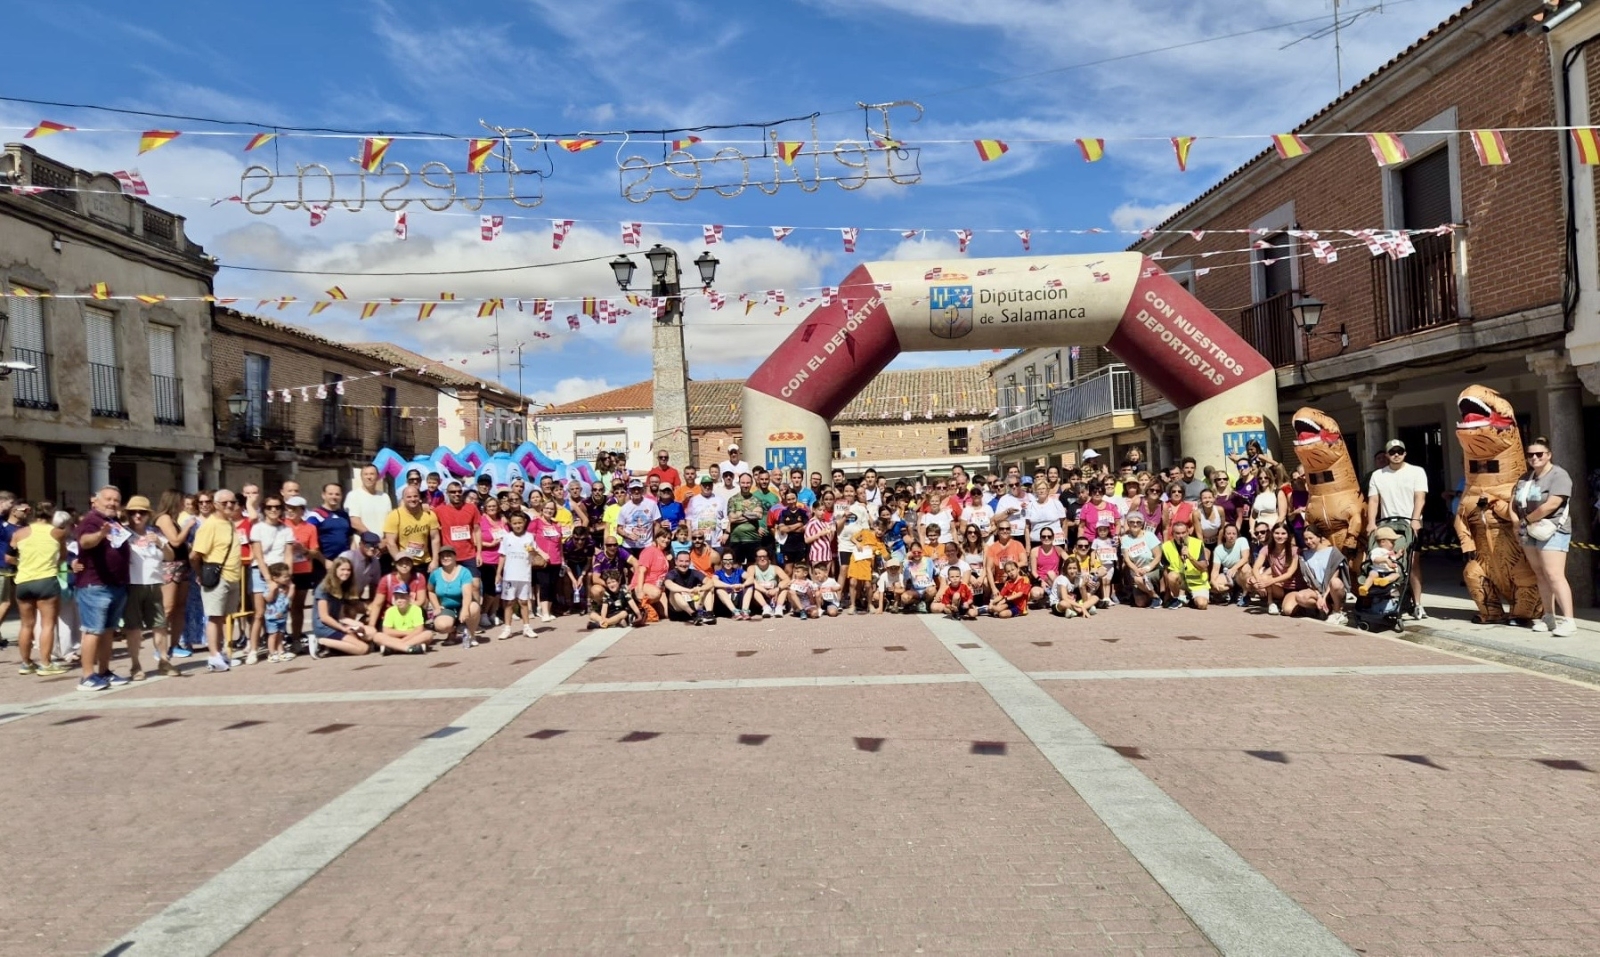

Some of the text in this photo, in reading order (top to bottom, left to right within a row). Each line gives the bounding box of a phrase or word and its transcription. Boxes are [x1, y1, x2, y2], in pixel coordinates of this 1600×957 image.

[780, 296, 882, 398] CON EL DEPORTE
[980, 307, 1086, 324] de Salamanca
[1135, 309, 1225, 386] DEPORTISTAS
[1144, 290, 1244, 376] CON NUESTROS
